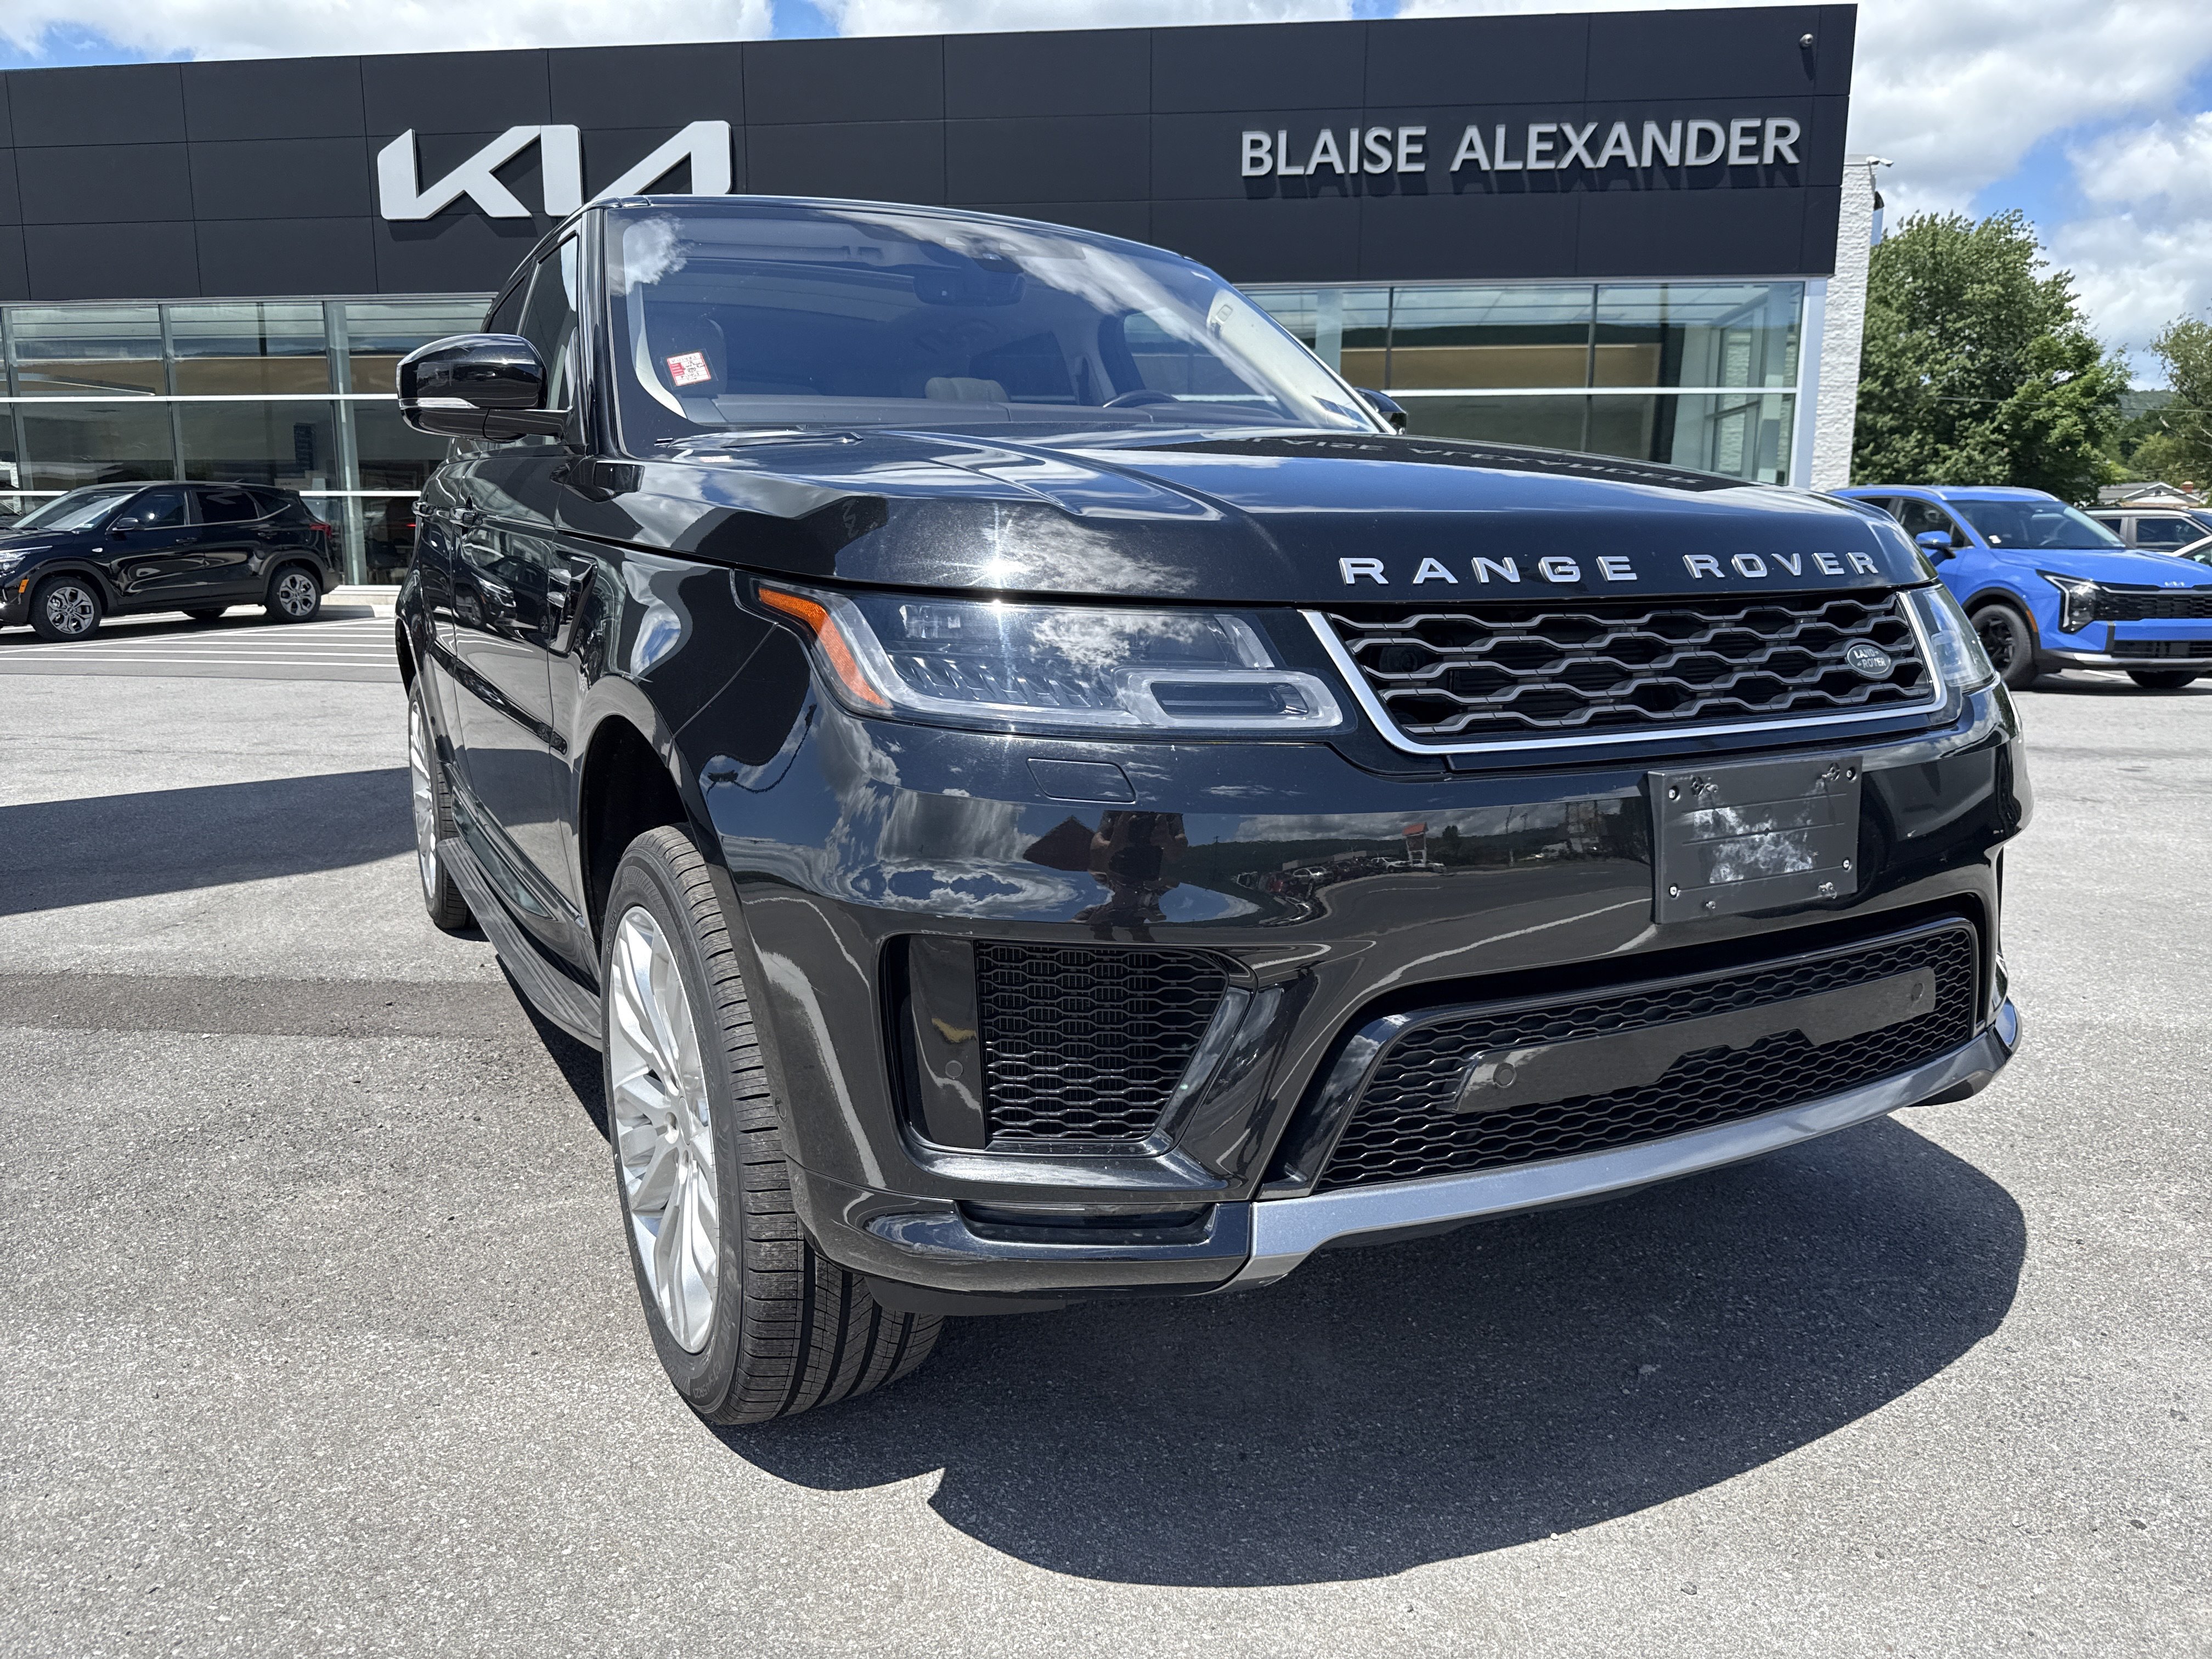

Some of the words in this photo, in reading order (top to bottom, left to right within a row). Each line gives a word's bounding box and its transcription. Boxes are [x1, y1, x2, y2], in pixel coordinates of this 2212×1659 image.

[1242, 126, 1426, 176] BLAISE
[1449, 117, 1801, 171] ALEXANDER
[377, 120, 731, 220] KIA
[1339, 556, 1638, 585] RANGE
[1682, 552, 1879, 579] ROVER
[1853, 648, 1876, 658] LAND
[1861, 658, 1886, 668] ROVER
